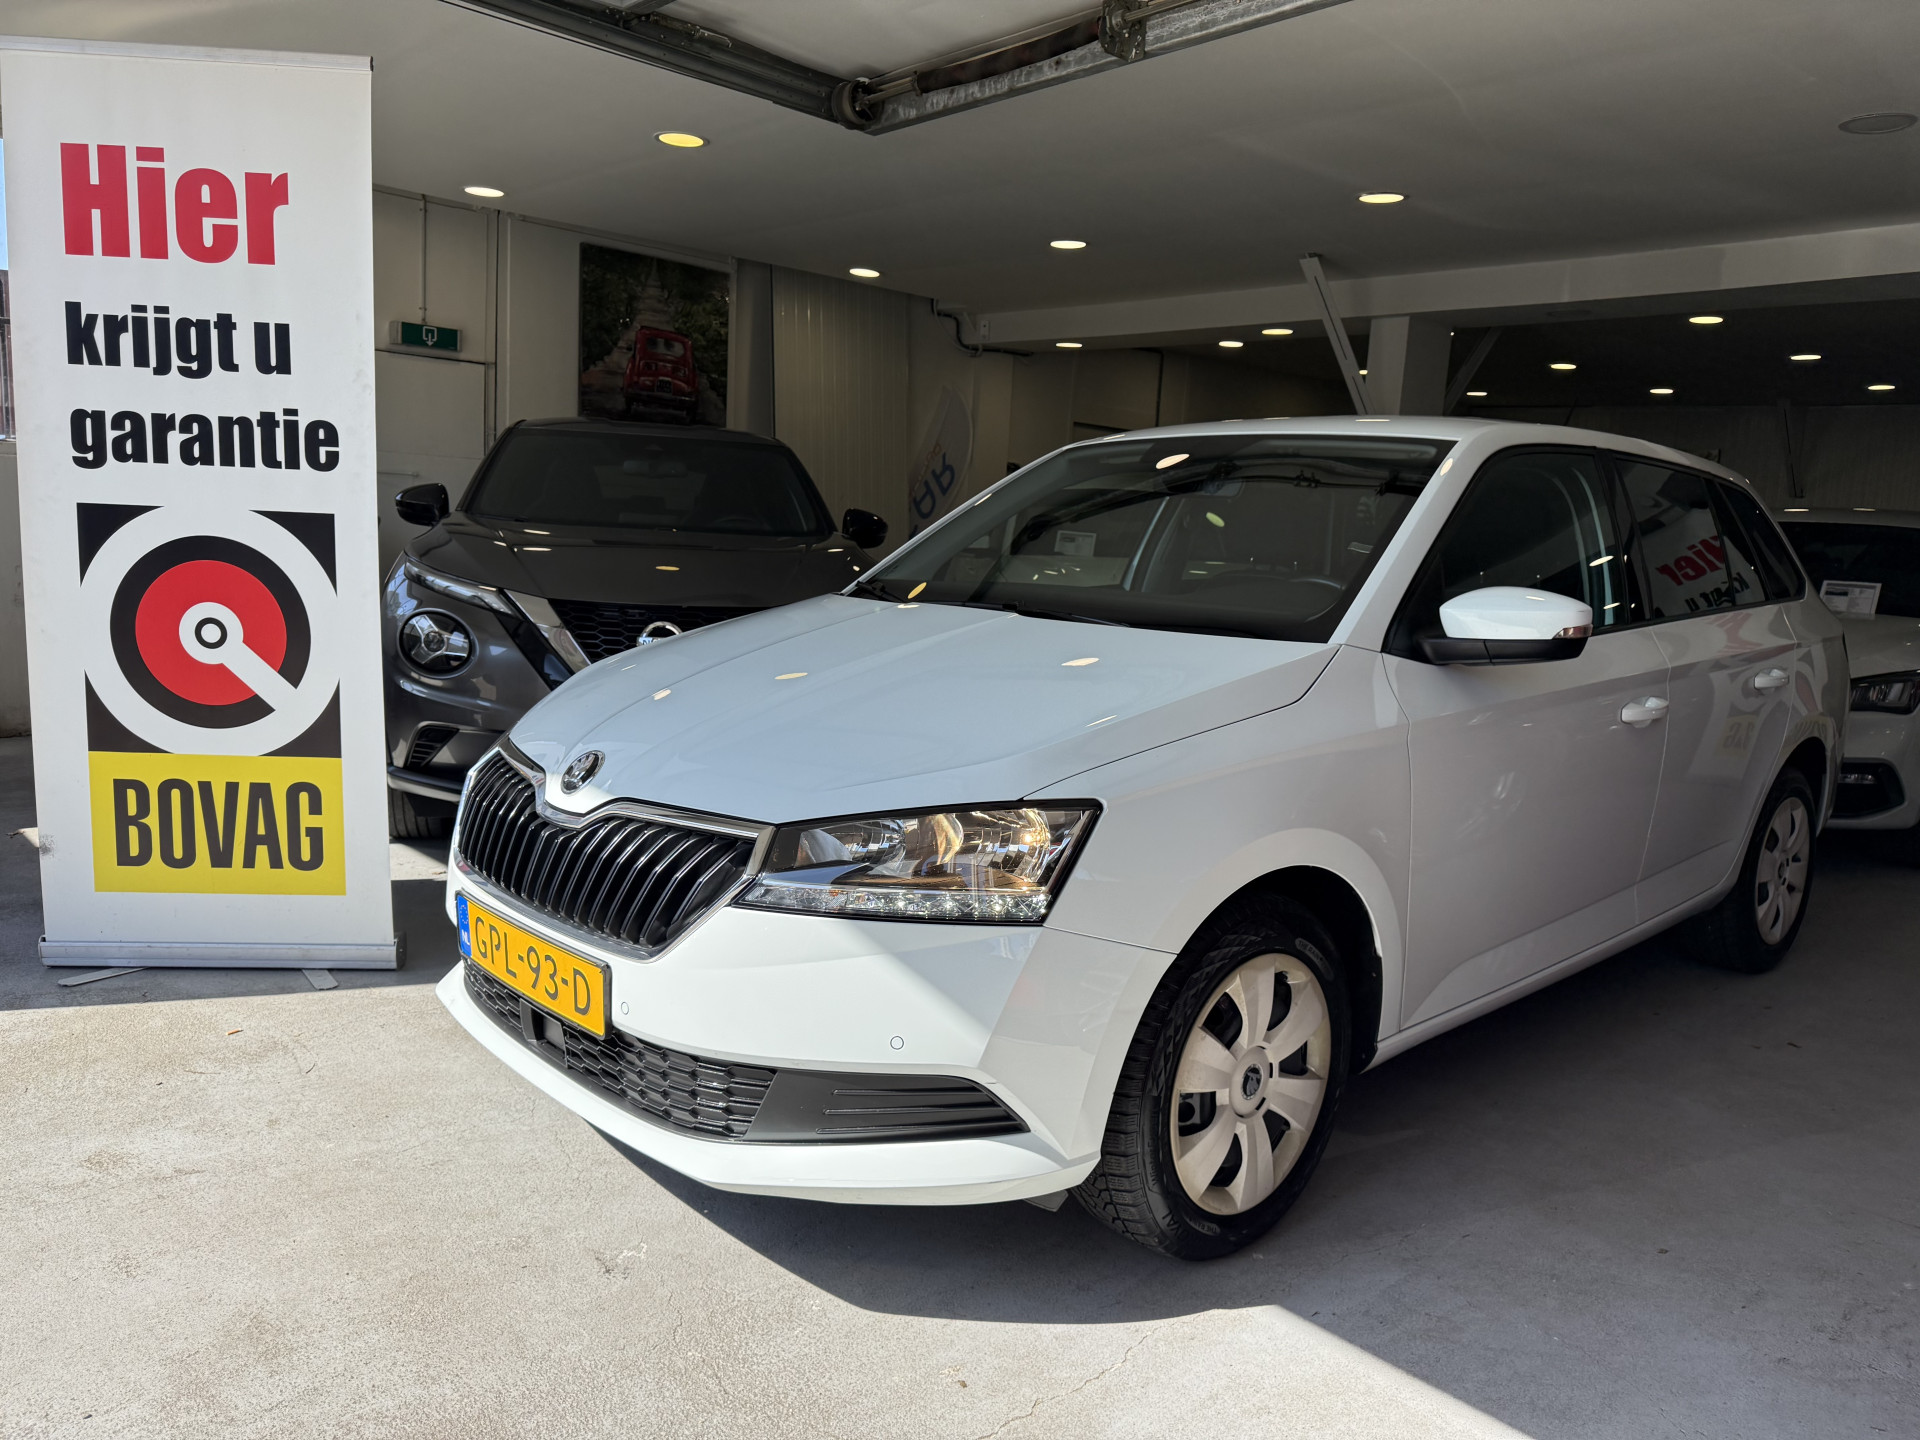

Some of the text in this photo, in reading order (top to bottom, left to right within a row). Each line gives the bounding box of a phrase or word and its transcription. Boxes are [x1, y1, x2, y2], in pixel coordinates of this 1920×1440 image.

[60, 143, 289, 265] Hier
[65, 301, 292, 379] krijgt u
[70, 408, 340, 472] garantie
[112, 778, 325, 872] BOVAG
[461, 929, 471, 946] NL
[475, 916, 591, 1016] GPL-93-D
